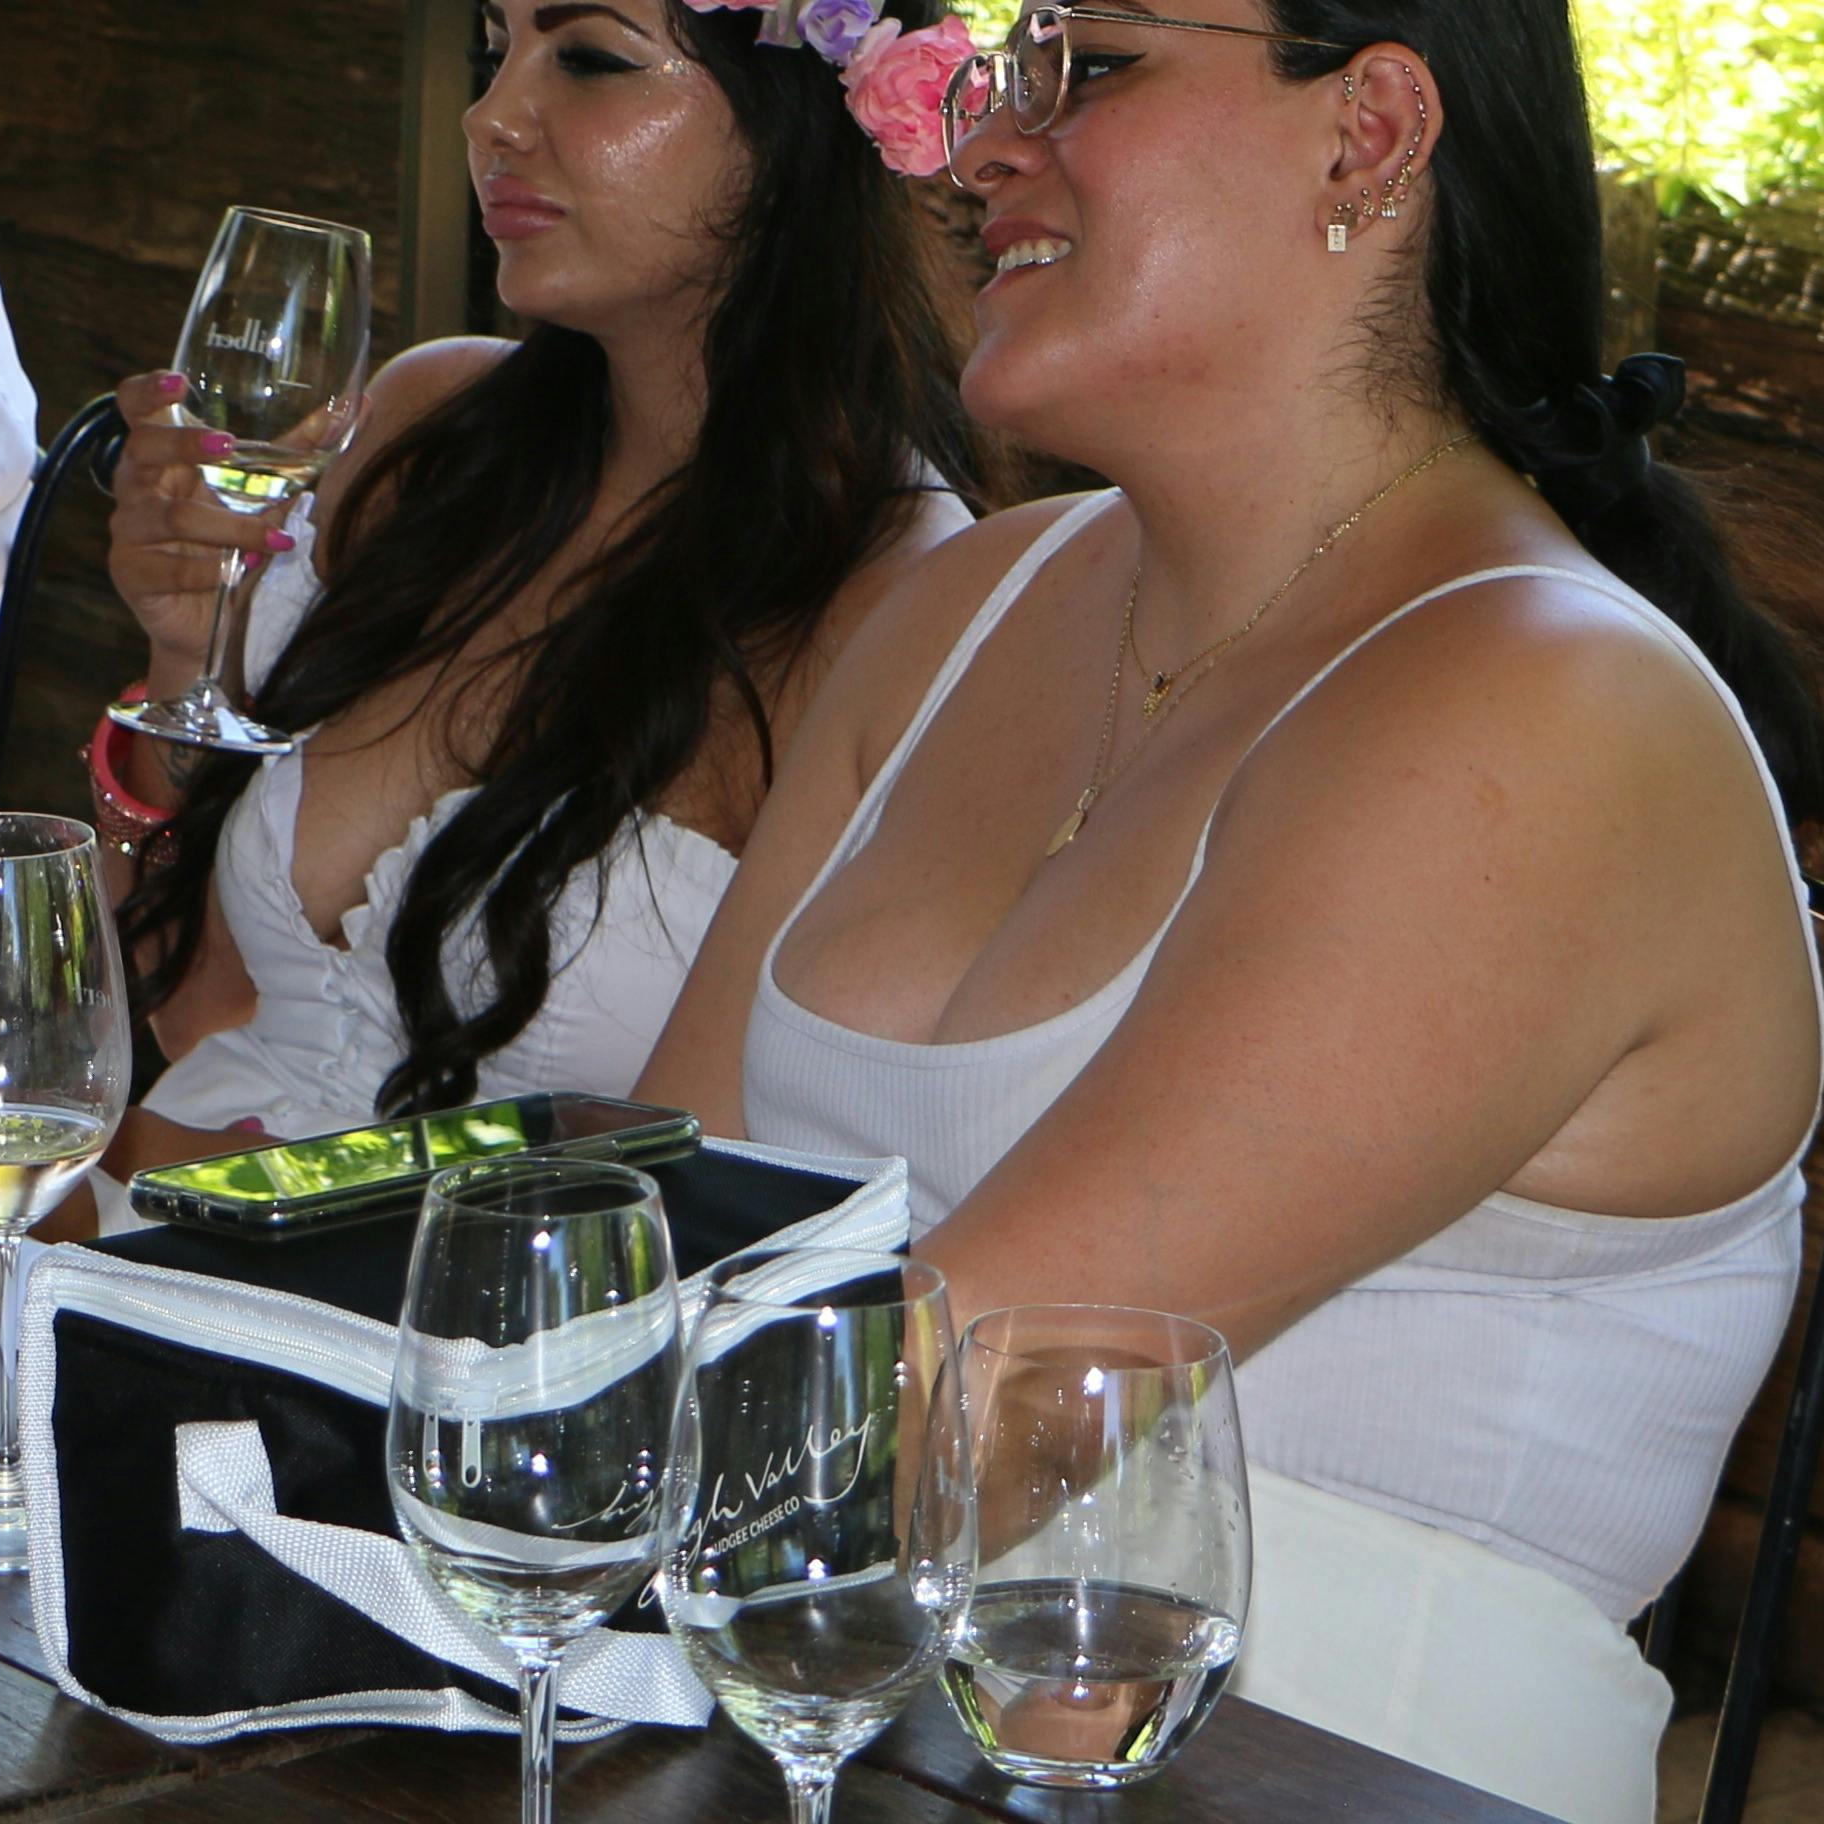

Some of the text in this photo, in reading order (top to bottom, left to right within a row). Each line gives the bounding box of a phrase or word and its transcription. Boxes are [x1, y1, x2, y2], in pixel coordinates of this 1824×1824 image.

[745, 1412, 872, 1505] Valley
[749, 1503, 785, 1538] CHEESE
[784, 1495, 800, 1517] CO
